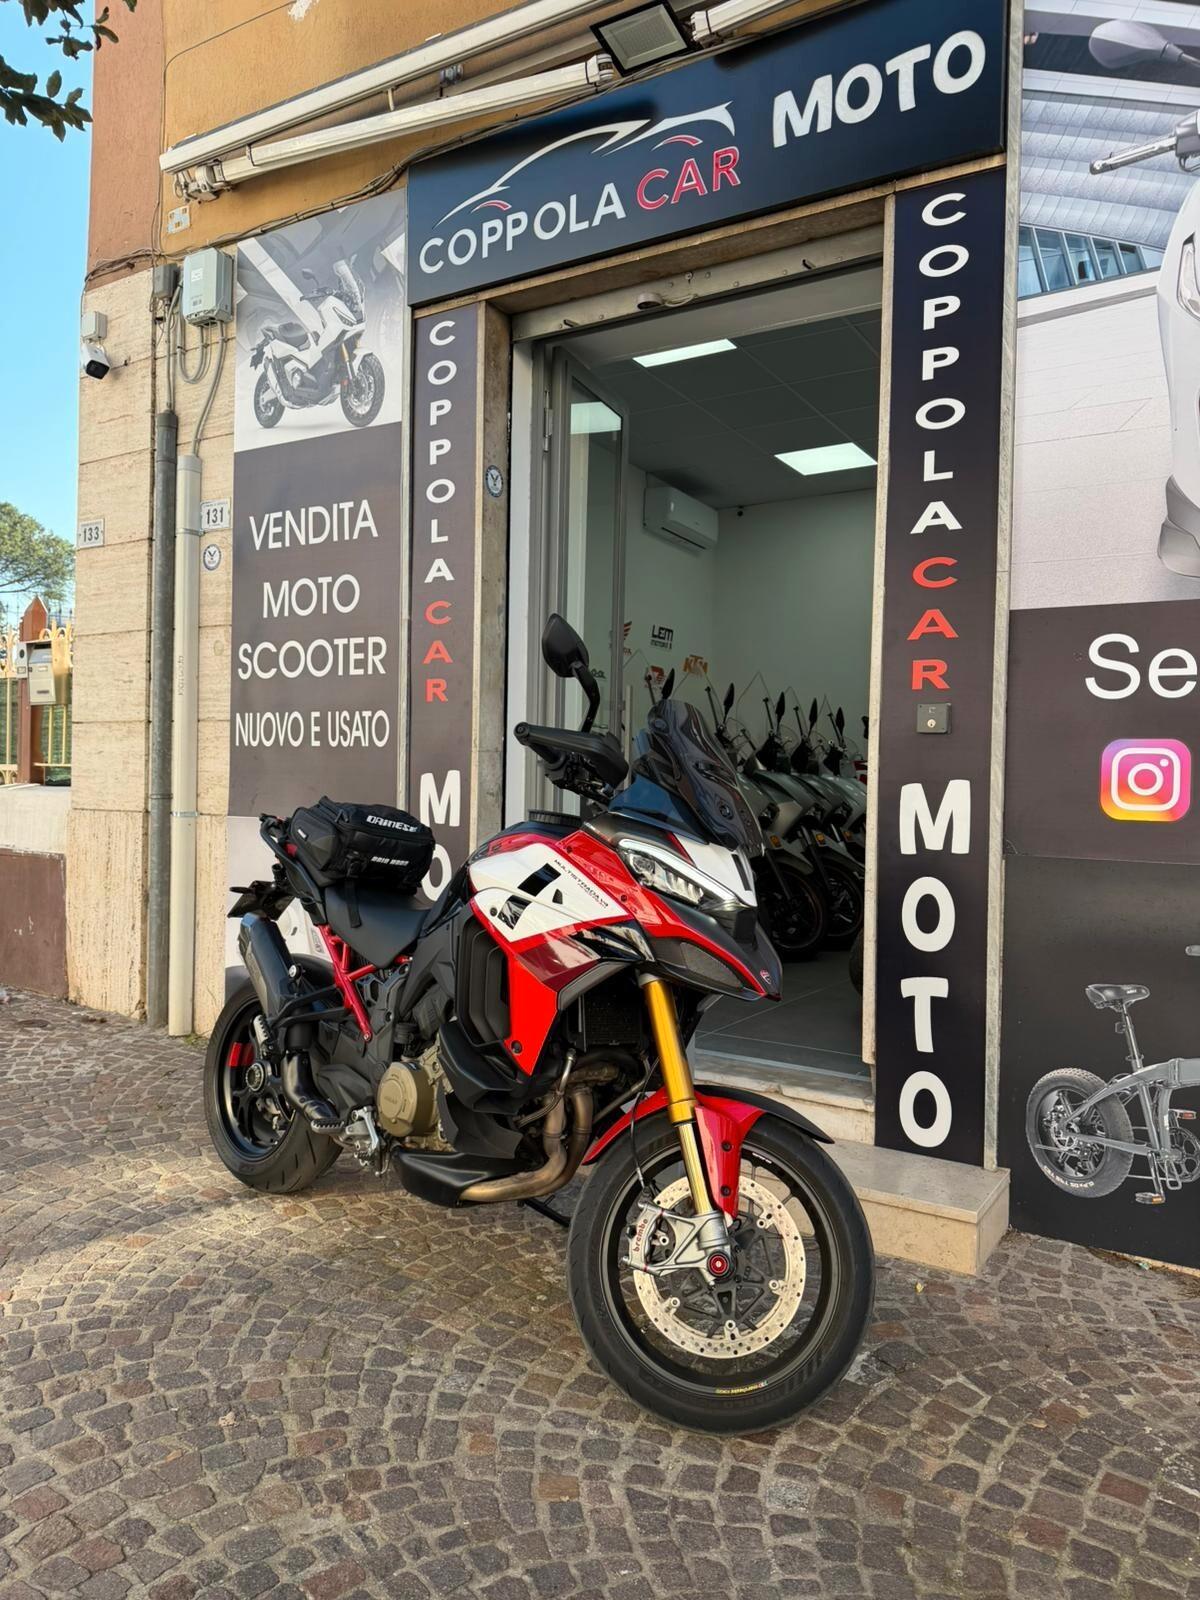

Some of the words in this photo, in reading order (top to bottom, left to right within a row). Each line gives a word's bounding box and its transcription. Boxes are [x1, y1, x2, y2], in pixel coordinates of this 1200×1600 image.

[772, 30, 987, 149] MOTO
[419, 182, 627, 275] COPPOLA
[636, 146, 741, 211] CAR
[910, 192, 970, 535] COPPOLA
[424, 319, 458, 584] COPPOLA
[83, 526, 100, 543] 133
[206, 506, 224, 525] 131
[249, 499, 379, 551] VENDITA
[263, 573, 361, 619] MOTO
[651, 624, 674, 642] LEM
[906, 556, 959, 691] CAR
[238, 636, 388, 681] SCOOTER
[423, 600, 454, 703] CAR
[1085, 632, 1198, 700] Se
[235, 710, 305, 748] NUOVO
[310, 710, 321, 747] E
[327, 709, 390, 748] USATO
[366, 815, 419, 833] DAINESE
[899, 779, 972, 1149] MOTO
[632, 1218, 648, 1252] brembo
